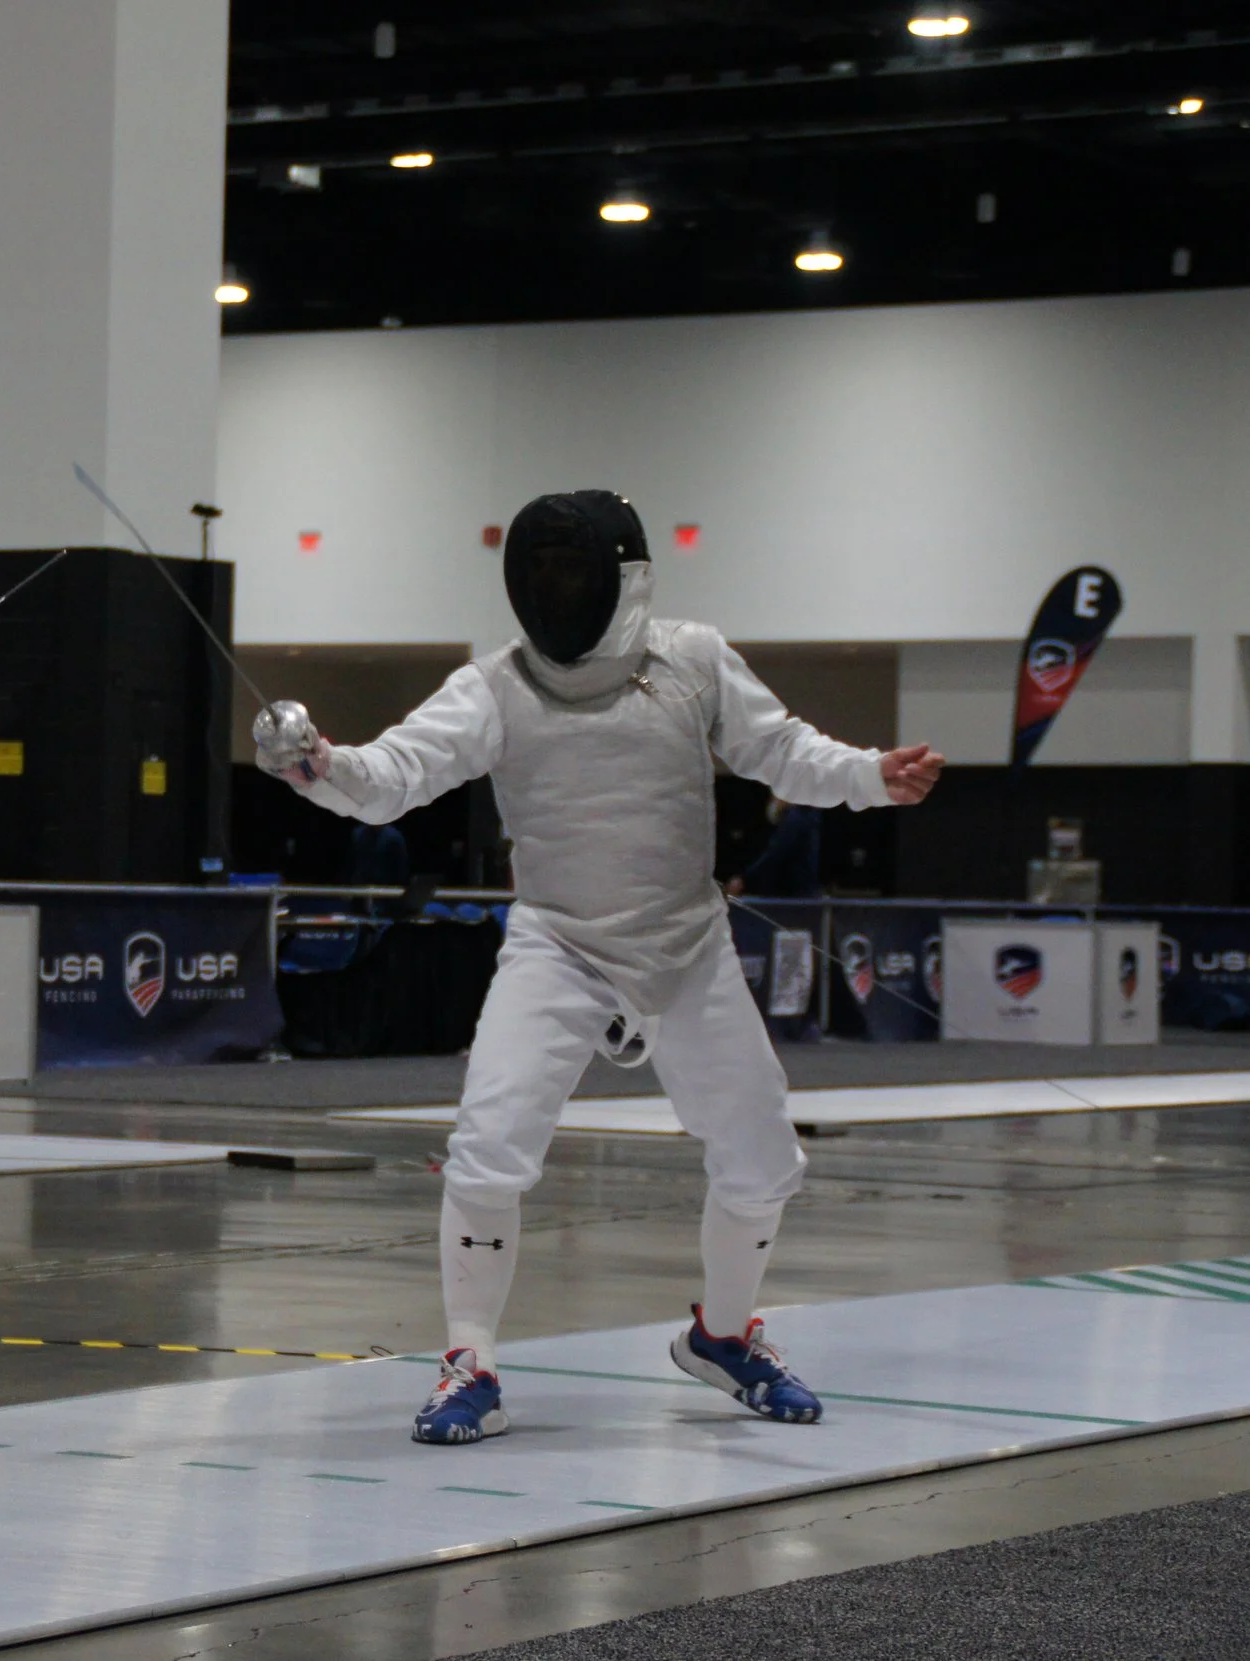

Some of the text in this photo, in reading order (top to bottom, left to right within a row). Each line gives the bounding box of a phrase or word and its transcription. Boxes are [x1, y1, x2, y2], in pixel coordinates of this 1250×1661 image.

[1074, 574, 1104, 618] E
[40, 954, 103, 982] USA
[177, 954, 238, 981] USA
[1192, 950, 1250, 973] US
[44, 990, 98, 1004] FENCING
